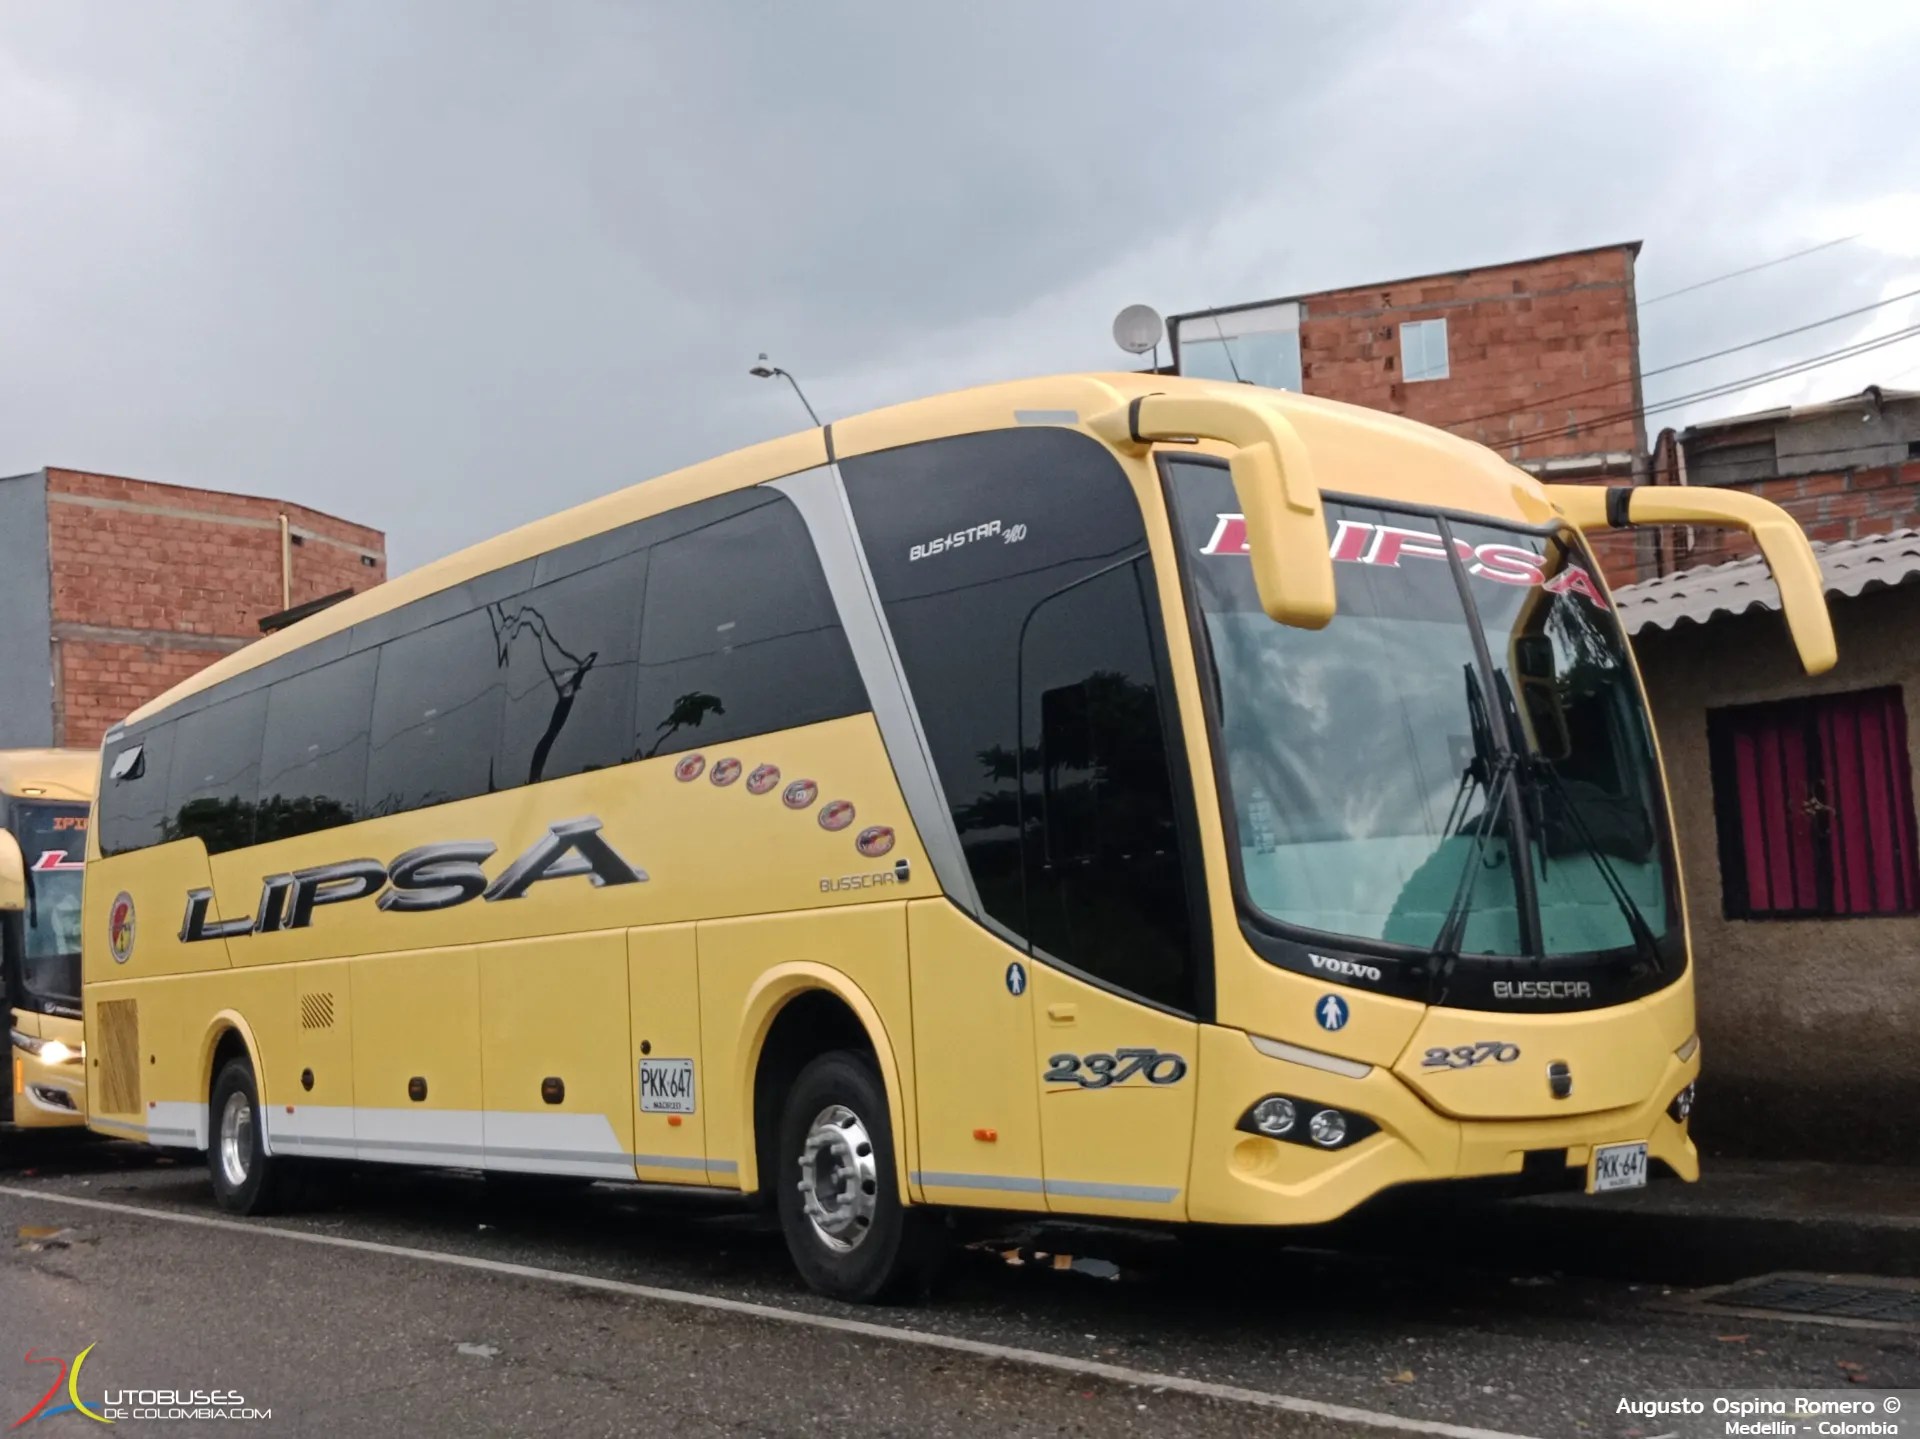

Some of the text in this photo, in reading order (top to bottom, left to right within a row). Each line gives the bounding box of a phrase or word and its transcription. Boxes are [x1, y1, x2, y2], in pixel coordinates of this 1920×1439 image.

[177, 815, 649, 943] LIPSA
[819, 872, 895, 893] BUSSCAR
[1308, 953, 1382, 981] VOLVO
[1493, 981, 1590, 998] BUSSCAR
[1043, 1048, 1187, 1089] 2370
[1422, 1041, 1521, 1070] 2370
